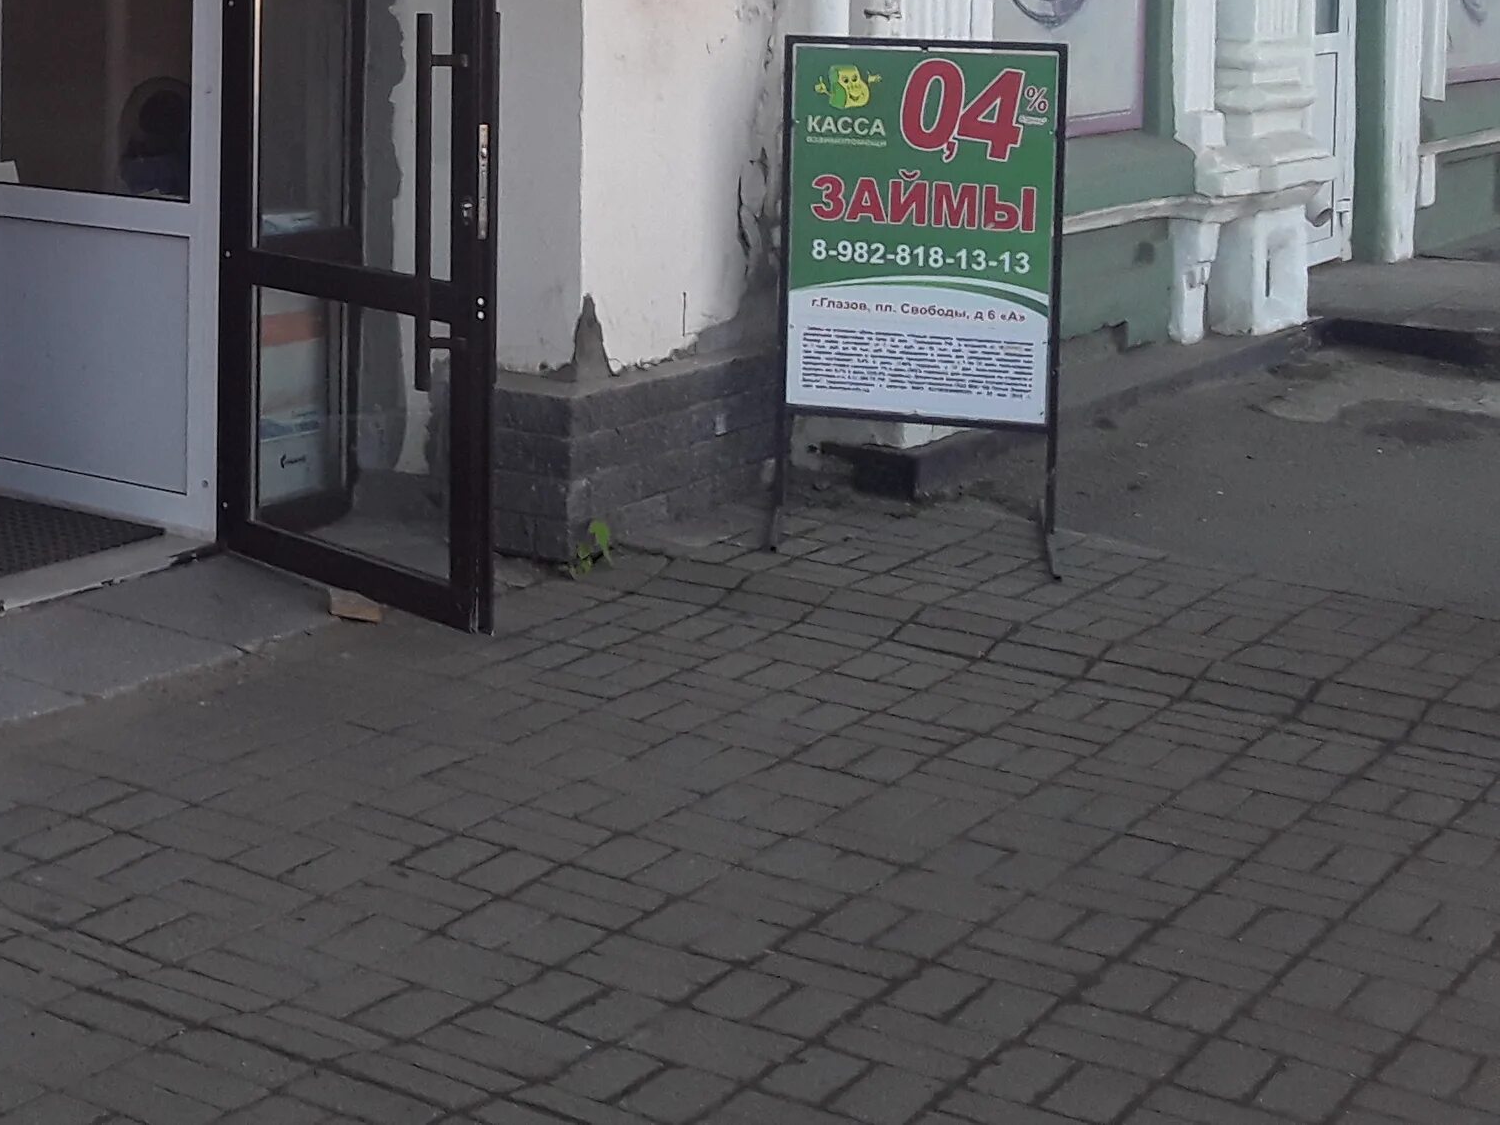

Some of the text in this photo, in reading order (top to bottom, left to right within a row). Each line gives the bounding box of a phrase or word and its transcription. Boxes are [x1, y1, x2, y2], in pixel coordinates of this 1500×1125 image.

[806, 114, 886, 137] КАССА
[811, 169, 1037, 233] ЗАЙМЫ
[811, 238, 1030, 274] 8-982-818-13-13
[875, 302, 897, 313] пл.
[900, 303, 971, 320] Свободы,
[974, 311, 985, 322] д
[987, 309, 996, 321] 6
